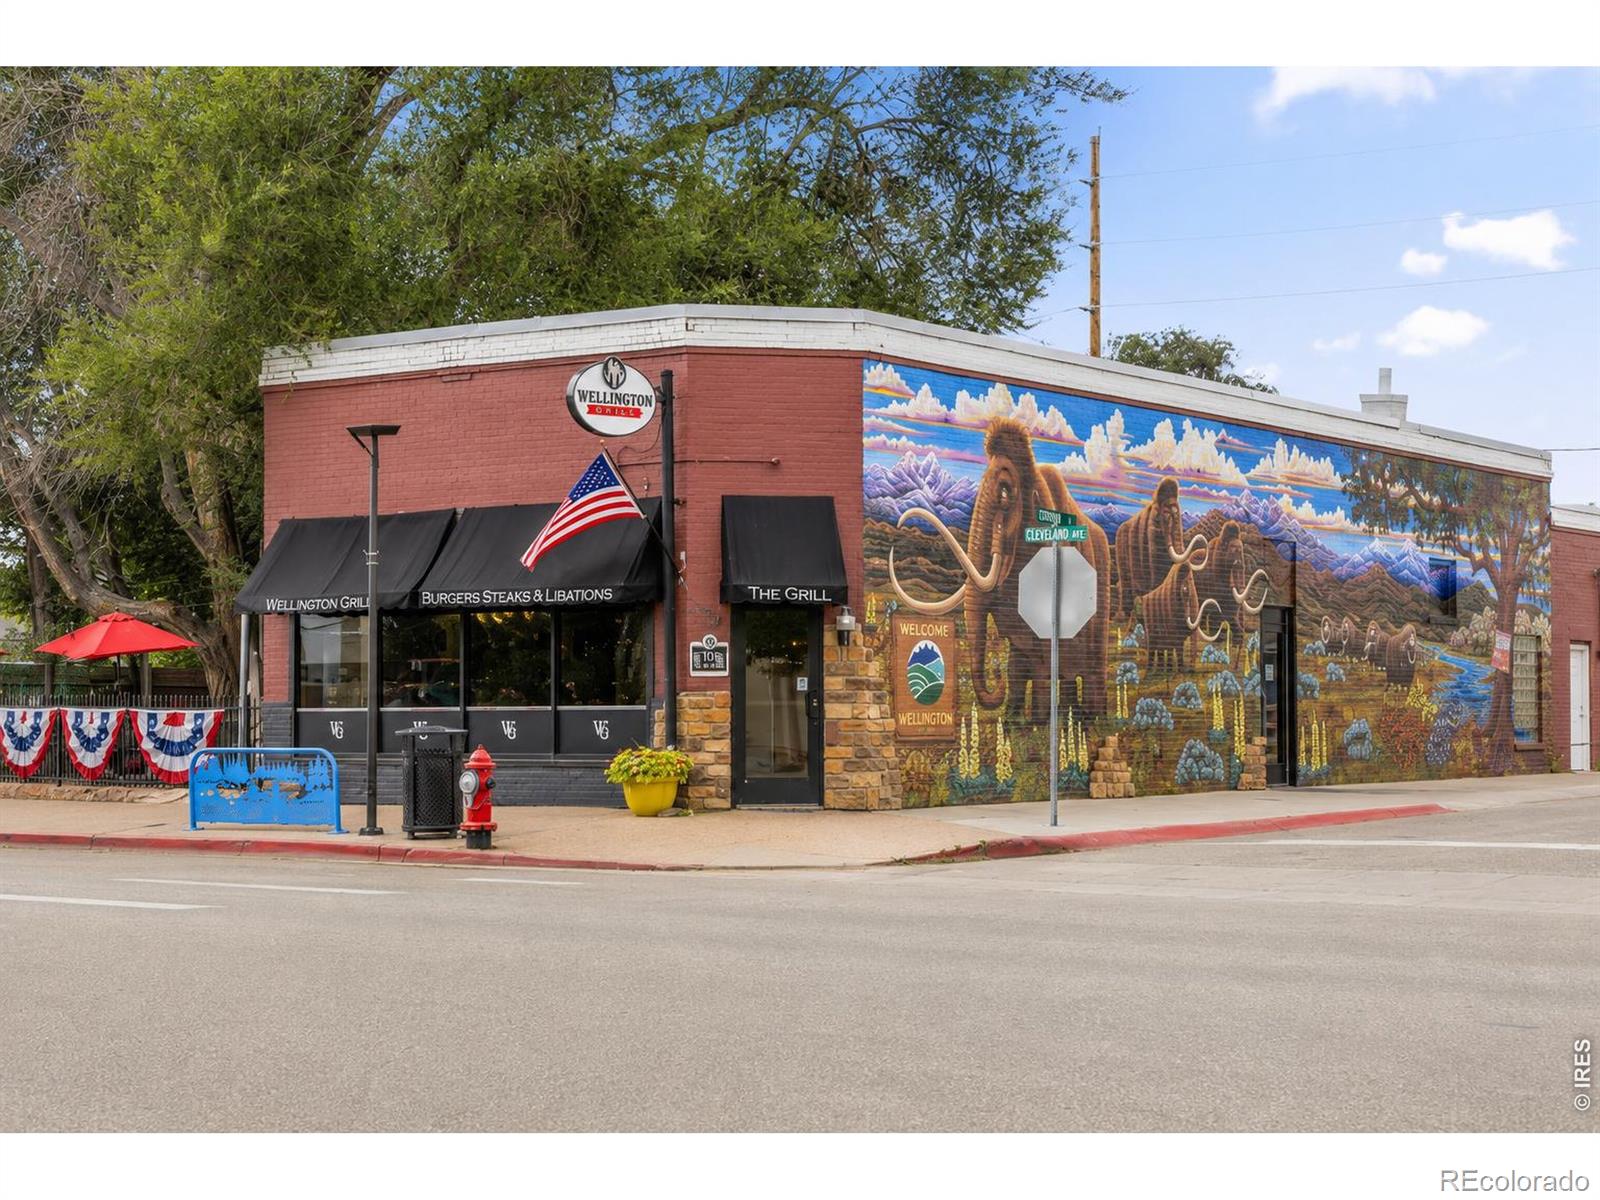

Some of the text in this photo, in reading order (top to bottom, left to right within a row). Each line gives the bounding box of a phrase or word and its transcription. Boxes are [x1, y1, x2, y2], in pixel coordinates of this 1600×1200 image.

[577, 390, 653, 407] WELLINGTON
[1026, 528, 1086, 541] CLEVELAND AVE
[422, 588, 613, 604] BURGERS STEAKS & LIBATIONS
[747, 586, 832, 602] THE GRILL
[266, 598, 338, 611] WELLINGTON
[900, 623, 948, 636] WELCOME
[898, 712, 953, 726] WELLINGTON
